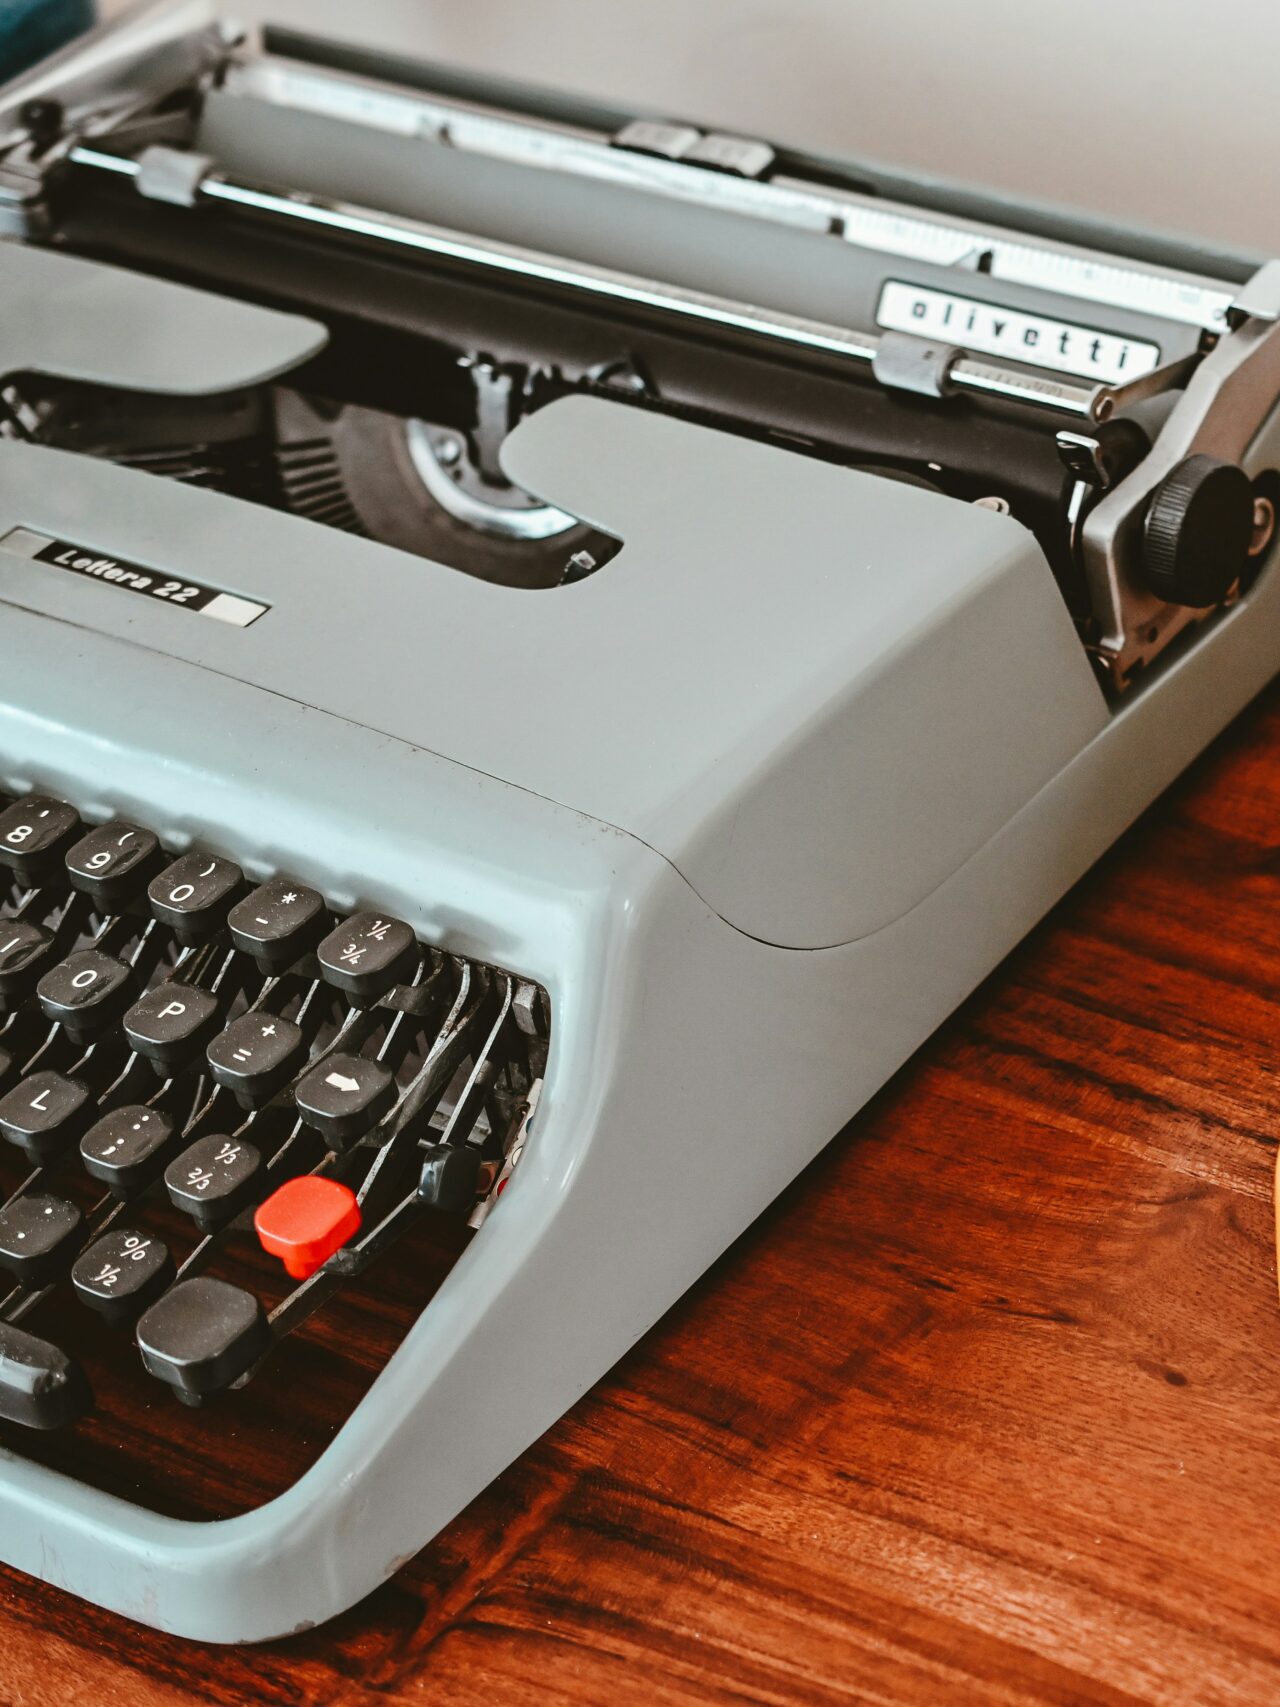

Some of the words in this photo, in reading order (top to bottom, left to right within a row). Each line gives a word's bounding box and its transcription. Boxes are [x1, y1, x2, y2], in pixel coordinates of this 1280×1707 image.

[911, 301, 1129, 369] olivetti
[53, 549, 152, 590] Lettera
[152, 580, 201, 603] 22
[6, 825, 34, 843] 8
[85, 850, 111, 870] 9
[72, 969, 98, 988] O
[157, 1001, 186, 1019] P
[30, 1089, 51, 1111] L
